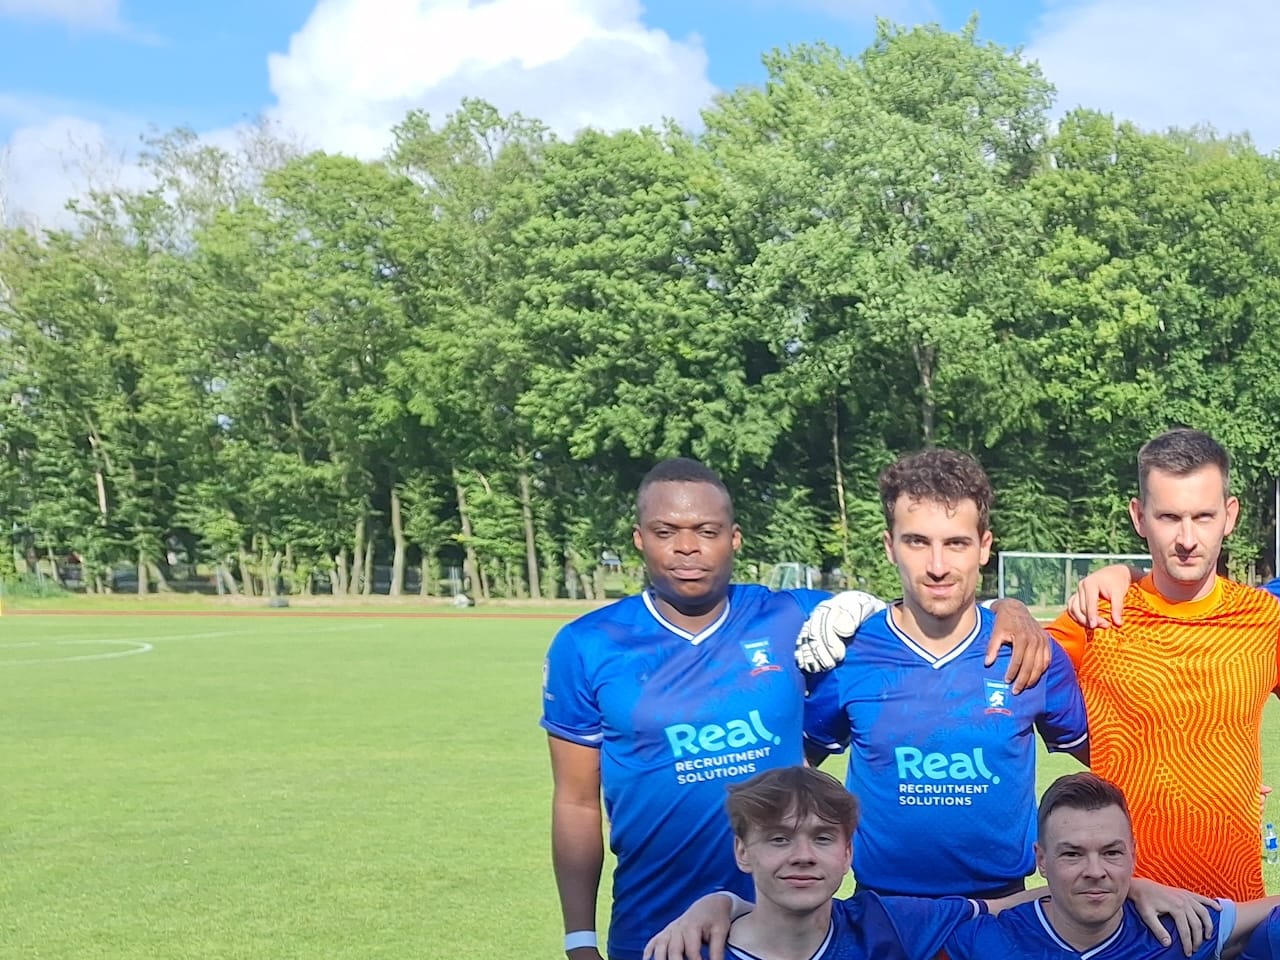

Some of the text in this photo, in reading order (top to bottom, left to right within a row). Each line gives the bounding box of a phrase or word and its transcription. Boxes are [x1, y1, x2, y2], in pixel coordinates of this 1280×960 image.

[664, 709, 781, 759] Real.
[674, 747, 771, 773] RECRUITMENT
[895, 746, 1001, 785] Real.
[676, 763, 757, 785] SOLUTIONS
[898, 784, 990, 794] RECRUITMENT
[898, 796, 973, 806] SOLUTIONS
